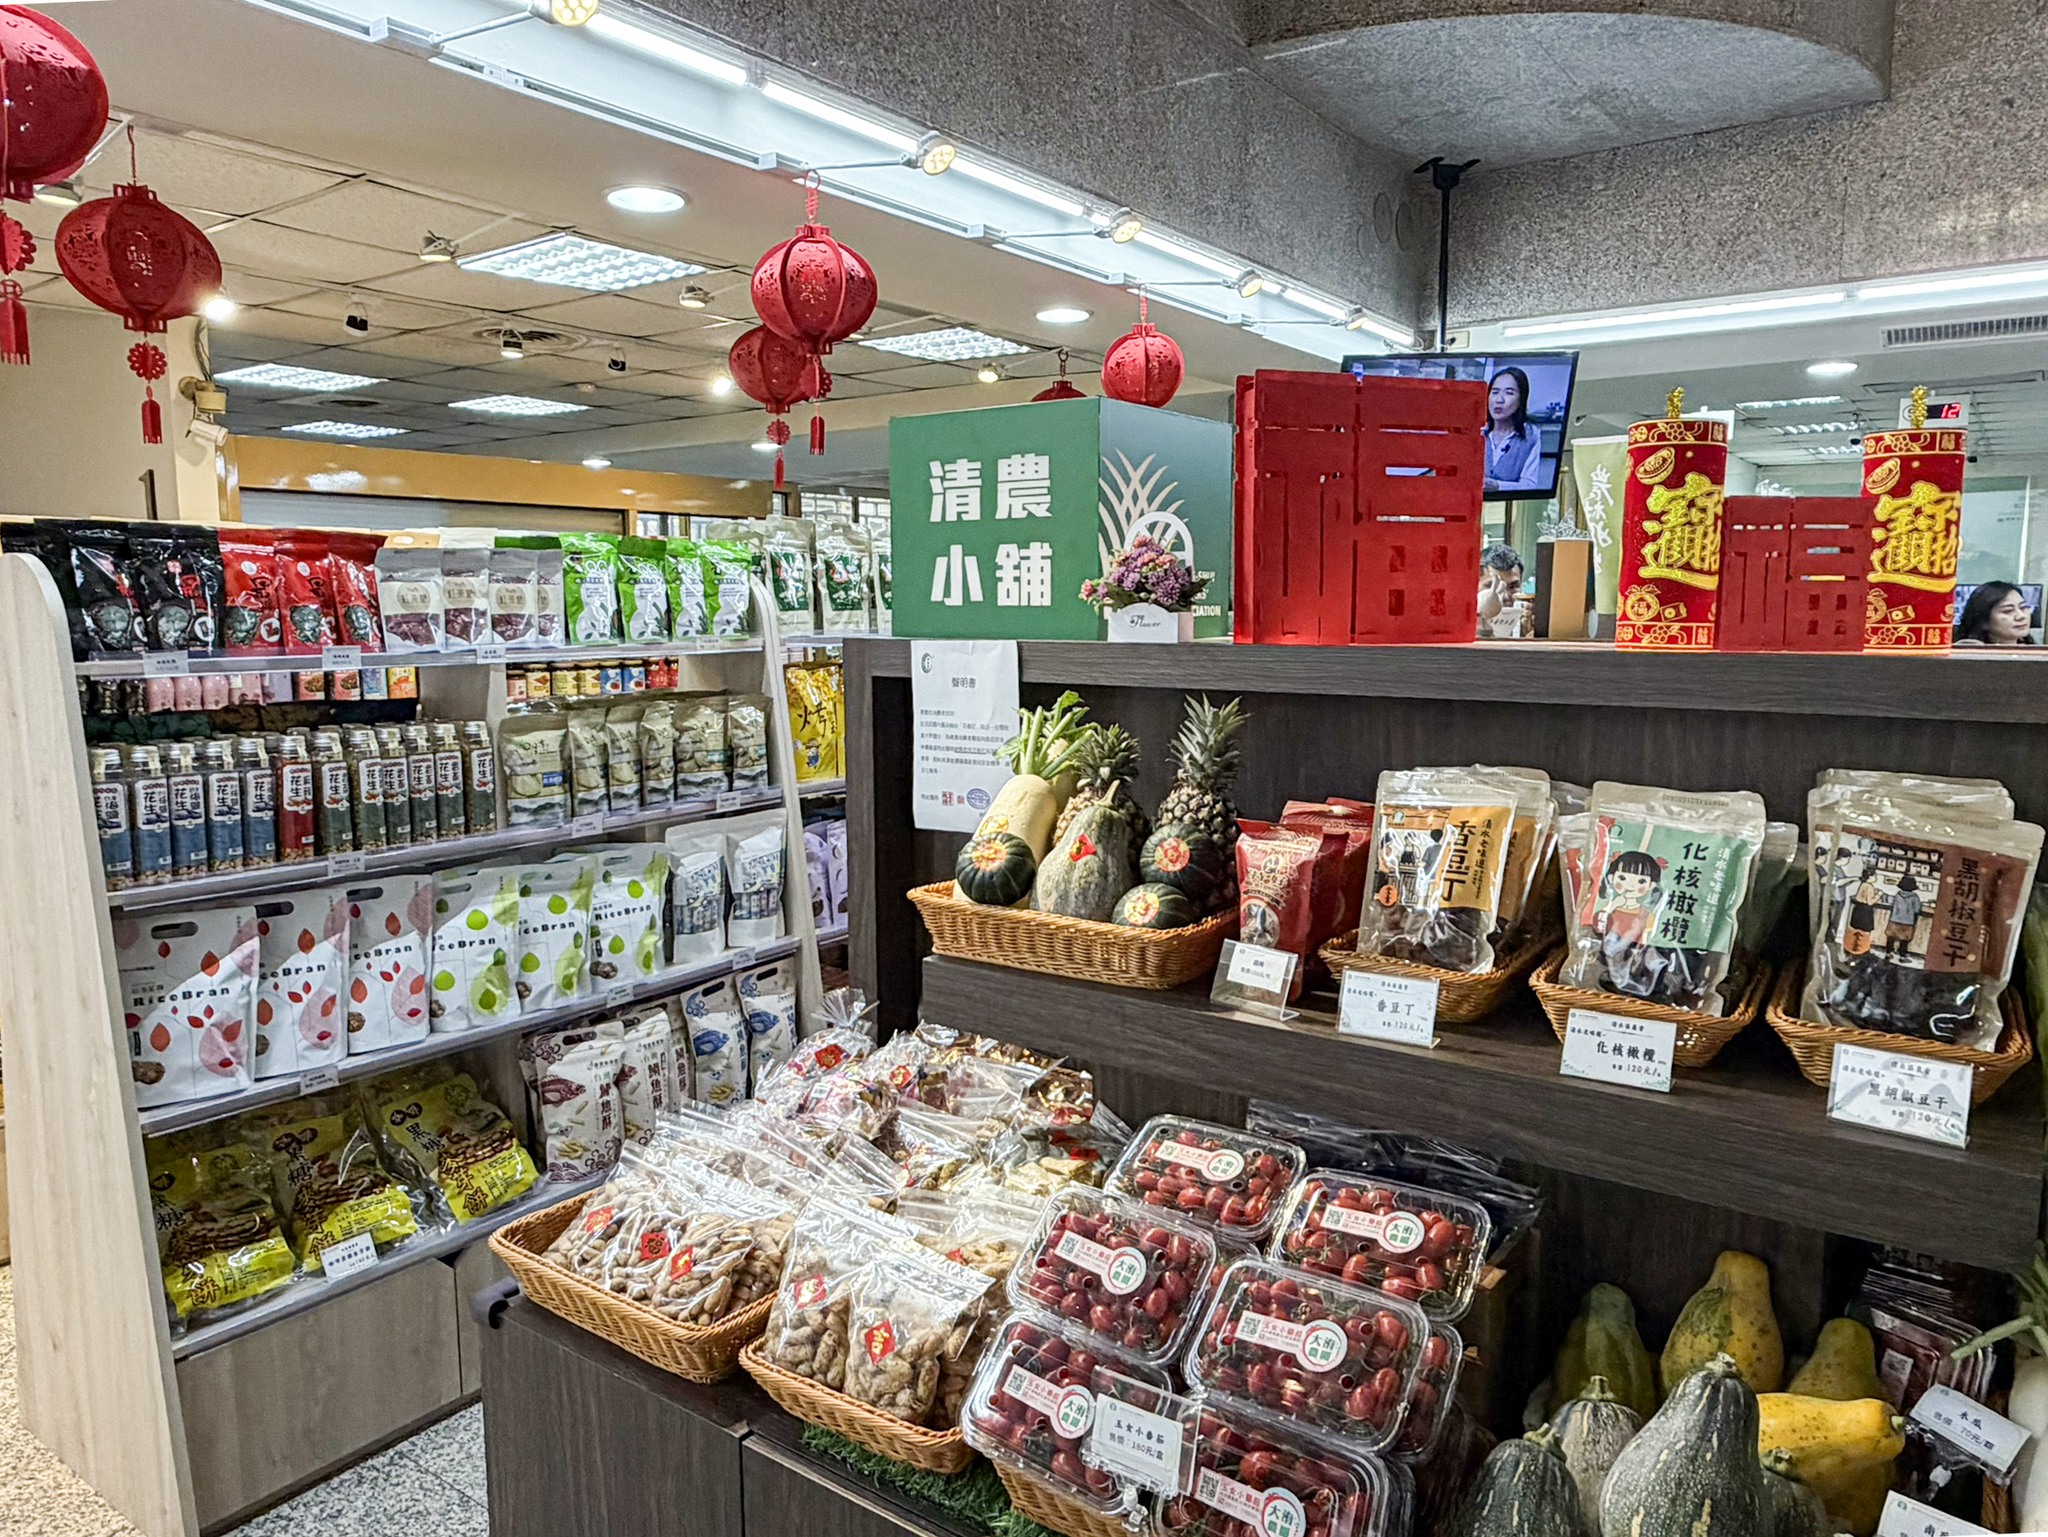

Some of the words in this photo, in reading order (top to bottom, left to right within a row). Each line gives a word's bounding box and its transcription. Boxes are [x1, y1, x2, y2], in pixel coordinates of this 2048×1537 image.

[1940, 402, 1962, 419] 12
[928, 452, 1053, 523] 清農
[929, 541, 1053, 606] 小舖
[329, 773, 341, 795] 花生
[413, 765, 424, 786] 花生
[439, 762, 449, 783] 花生
[217, 784, 230, 807] 花生
[253, 780, 266, 803] 花生
[289, 775, 302, 798] 花生
[143, 791, 157, 815] 花生
[174, 787, 188, 811] 花生
[1441, 820, 1477, 902] 香豆丁
[1660, 841, 1710, 944] 化核橄欖
[594, 902, 652, 923] RiceBran
[1942, 856, 1980, 967] 黑胡椒豆干
[518, 919, 576, 936] iceBran
[353, 943, 413, 961] ceBran
[259, 962, 326, 981] ceBran
[132, 985, 230, 1007] RiceBran
[1596, 1040, 1656, 1063] 化核橄欖
[1868, 1082, 1949, 1110] 黑胡椒豆干
[1114, 1418, 1166, 1446] 玉女小番茄
[1957, 1411, 1983, 1430] 木瓜
